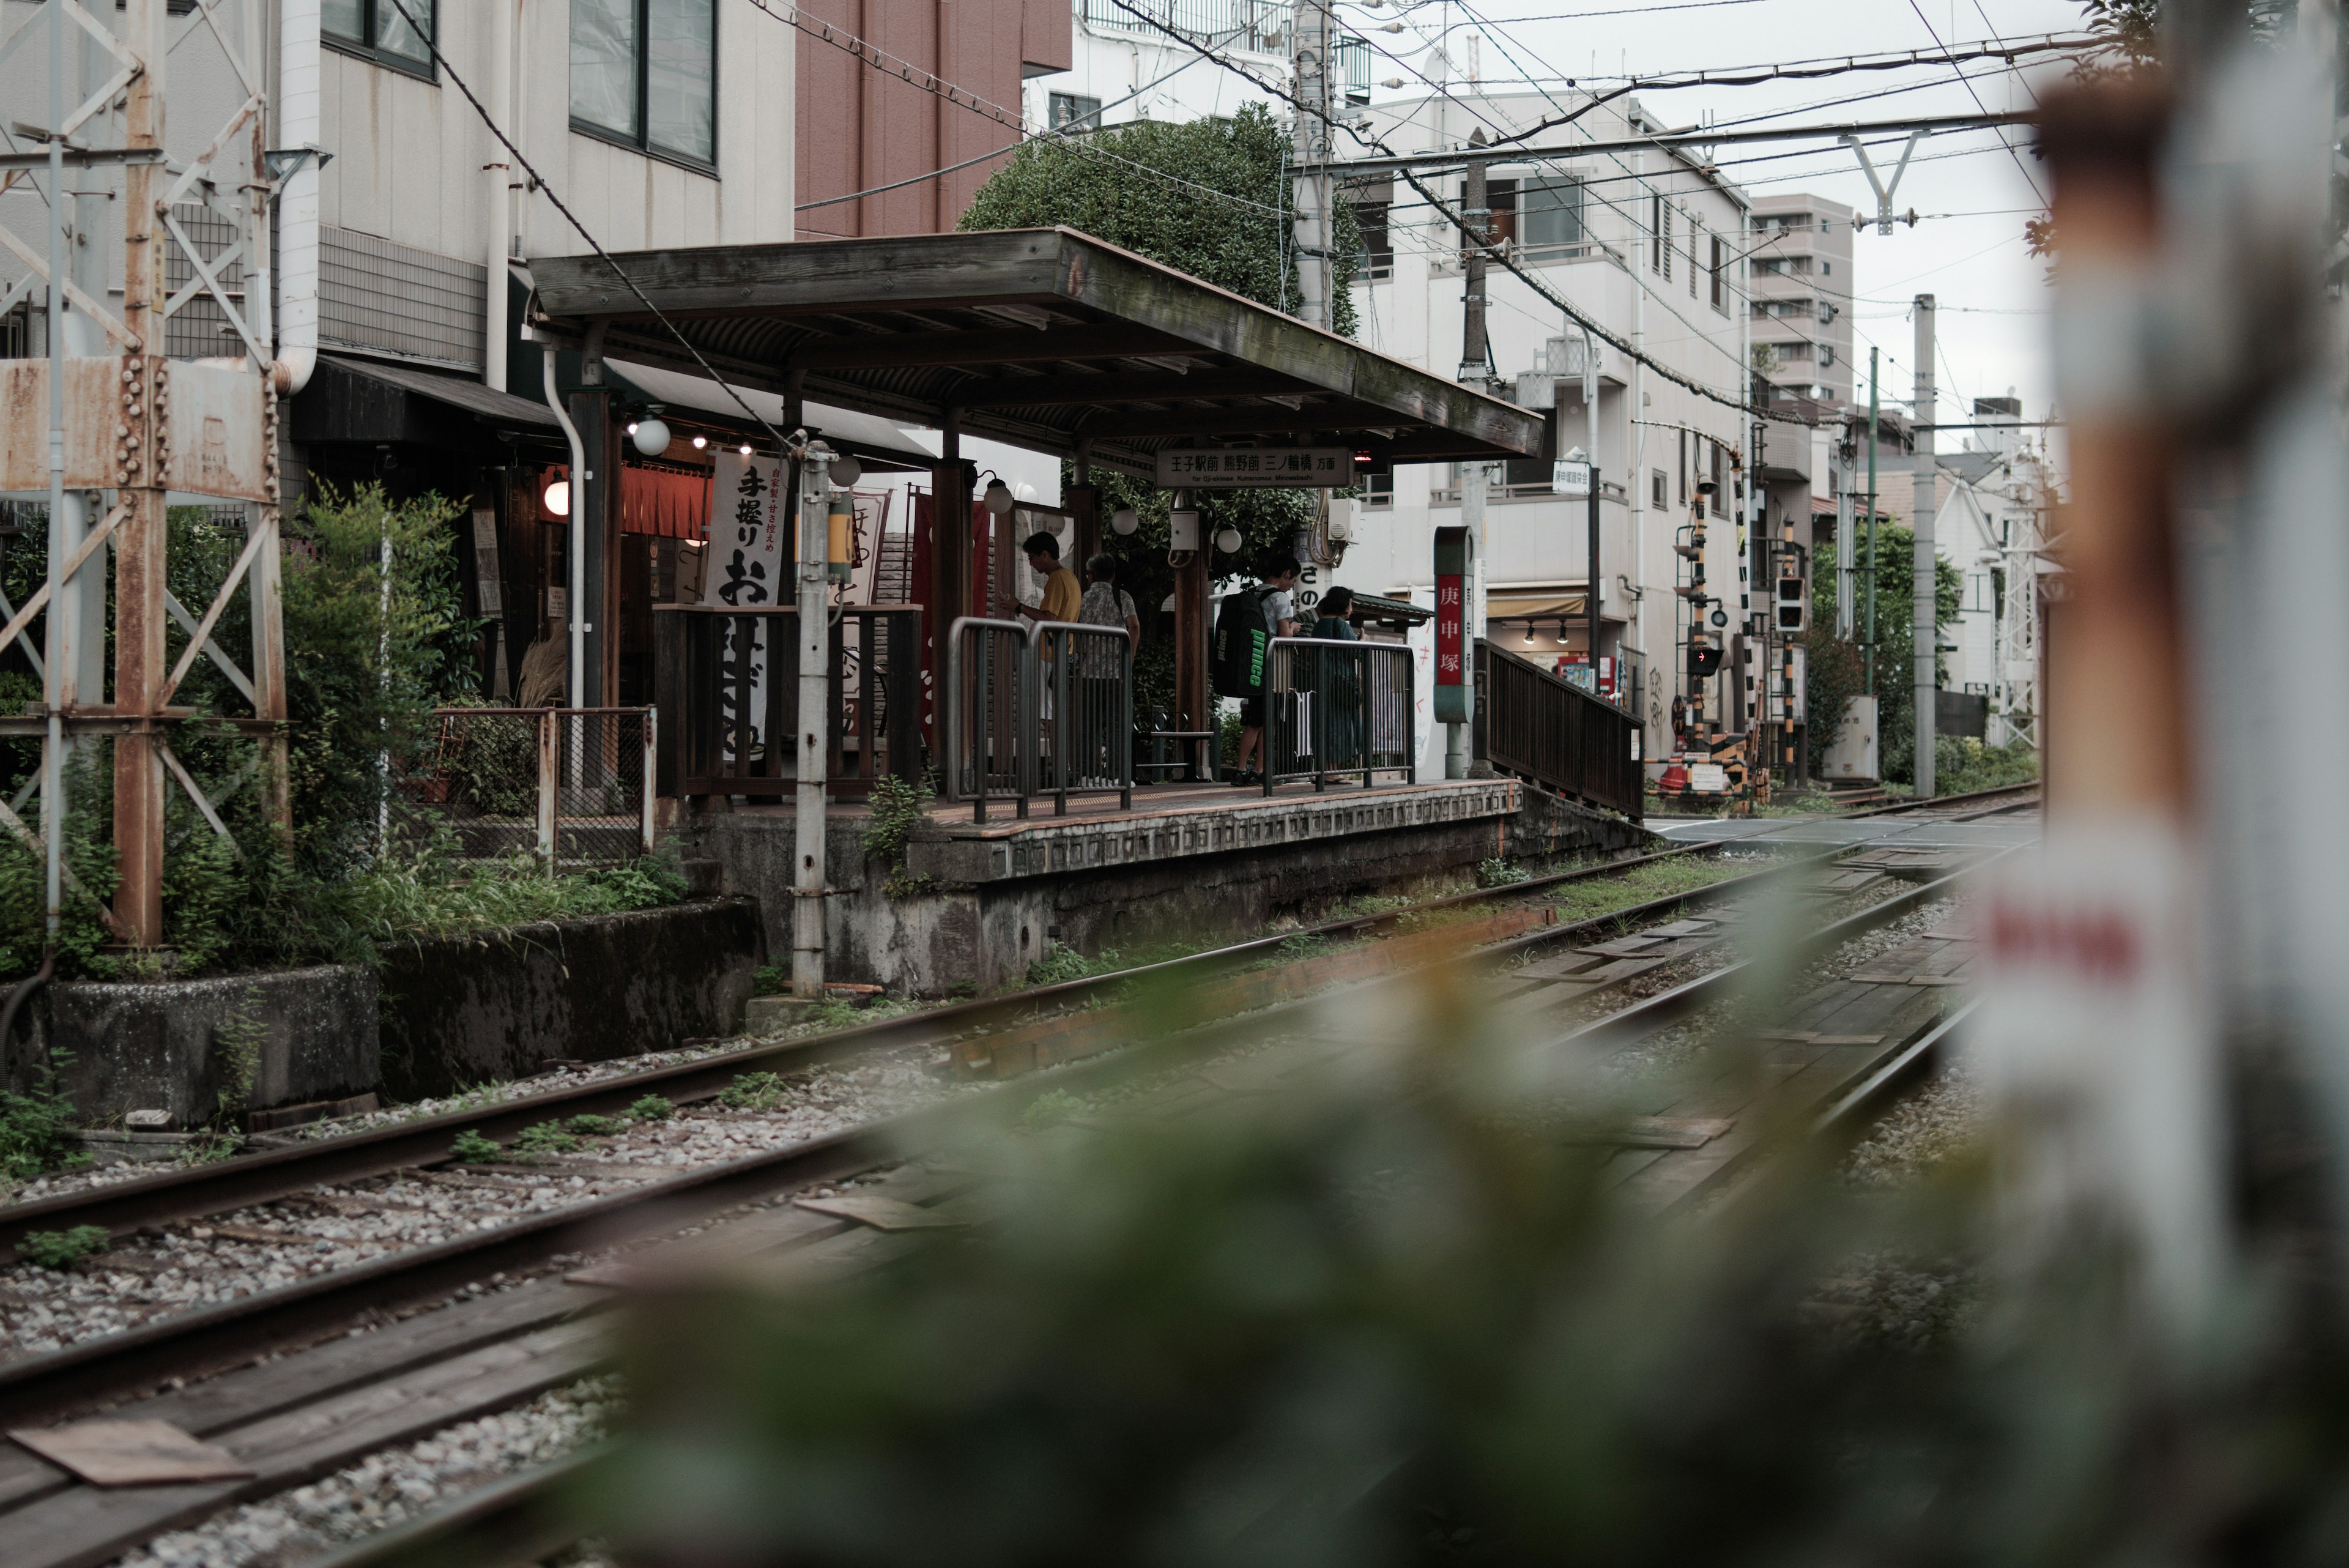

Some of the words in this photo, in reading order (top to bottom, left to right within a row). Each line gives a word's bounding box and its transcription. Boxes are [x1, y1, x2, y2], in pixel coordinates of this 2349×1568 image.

[1171, 455, 1219, 472] 王子駅前
[1224, 455, 1259, 471] 熊野前
[1265, 454, 1312, 471] 三ノ輪橋
[1316, 457, 1335, 470] 方面
[765, 468, 781, 552] 自家製・甘さ控えめ
[1217, 629, 1228, 661] prince
[1249, 628, 1266, 687] prince
[1440, 587, 1459, 672] 庚申塚
